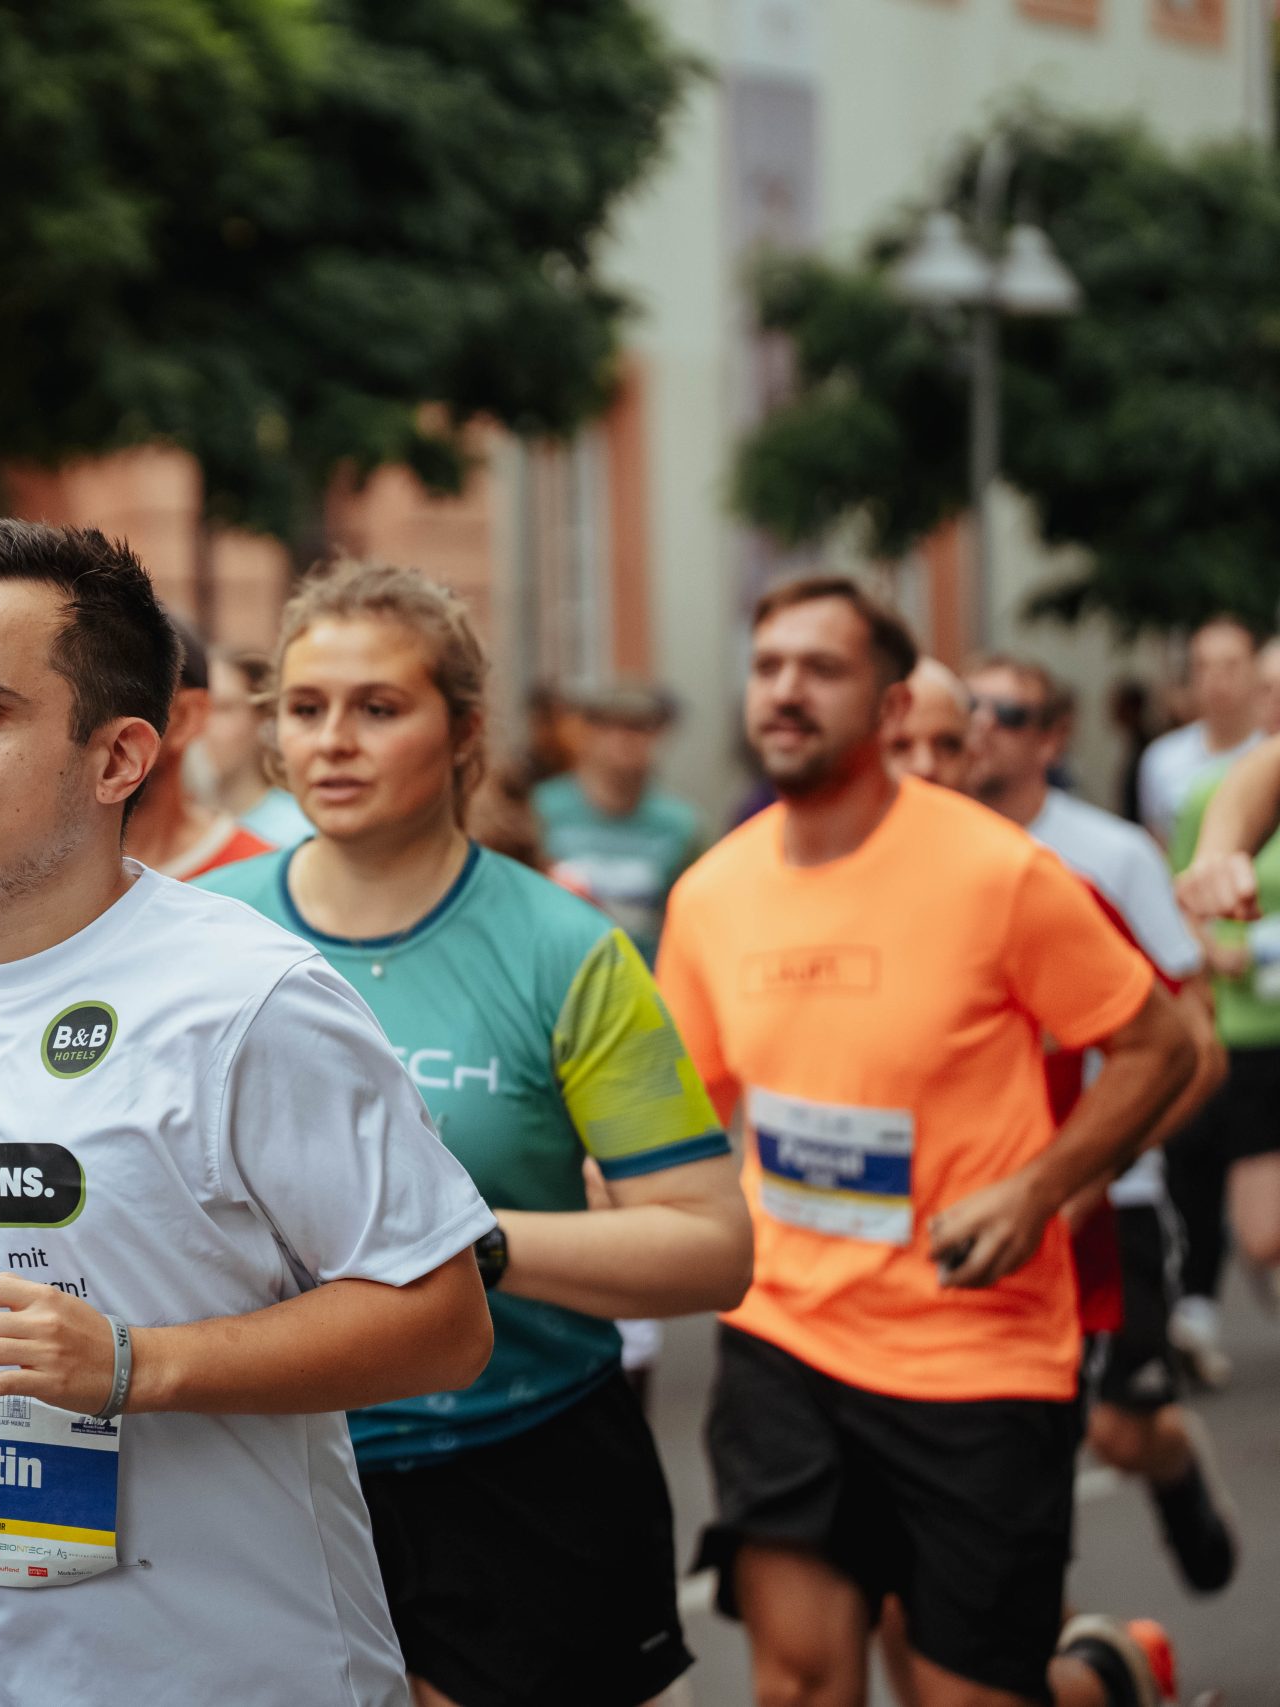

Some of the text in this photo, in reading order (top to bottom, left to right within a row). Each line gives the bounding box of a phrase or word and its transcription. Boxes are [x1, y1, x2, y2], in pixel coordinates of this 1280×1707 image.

[52, 1024, 108, 1048] B&B
[54, 1050, 96, 1061] HOTELS
[8, 1247, 49, 1269] mit
